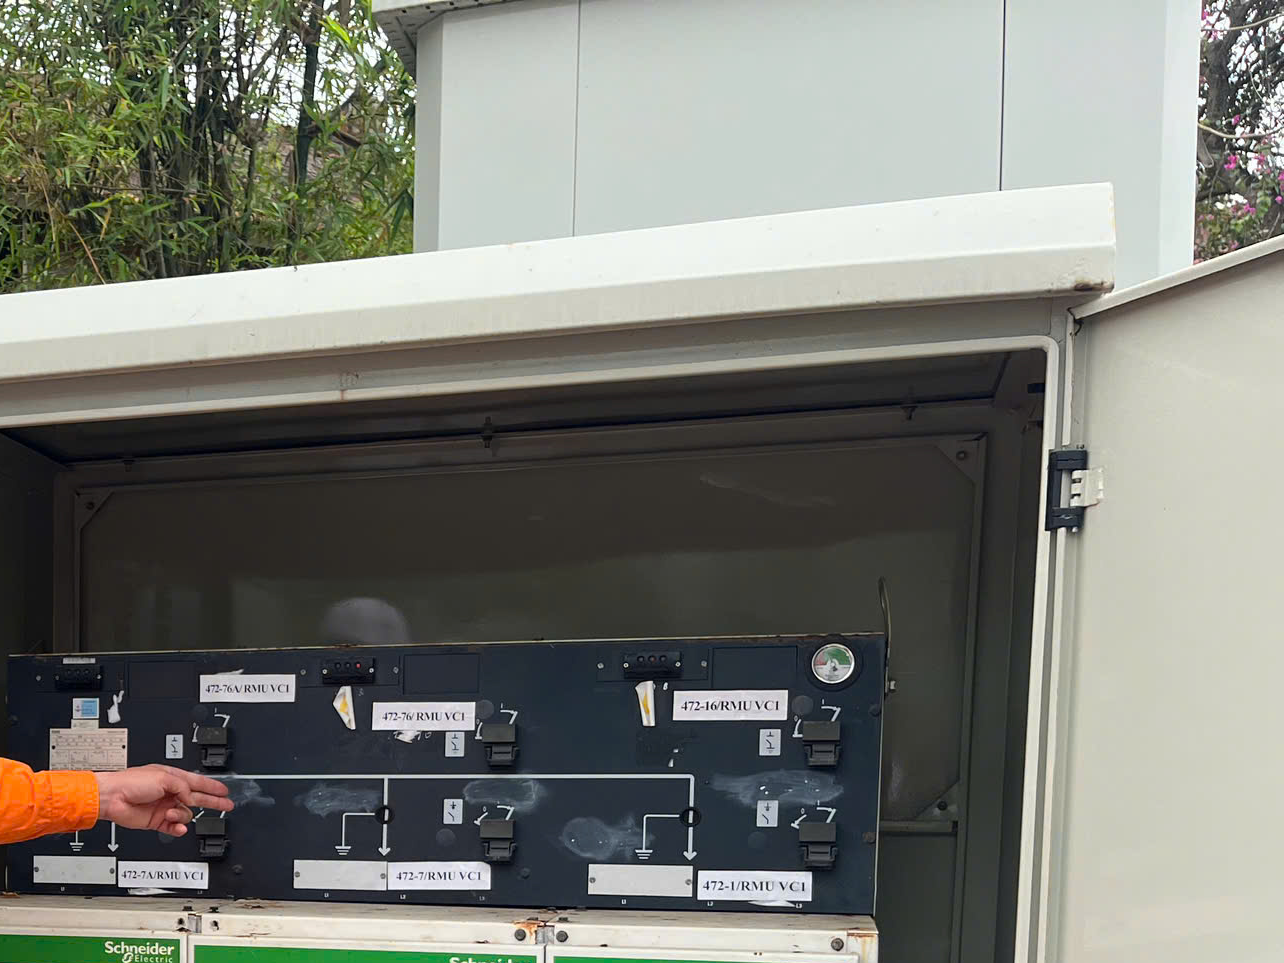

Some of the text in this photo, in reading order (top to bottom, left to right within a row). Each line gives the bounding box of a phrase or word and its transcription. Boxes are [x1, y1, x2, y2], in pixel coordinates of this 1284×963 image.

[270, 684, 290, 694] VC1
[755, 700, 779, 711] VC1
[445, 712, 466, 721] VC1
[183, 871, 204, 881] VC1
[459, 871, 482, 881] VC1
[703, 881, 805, 892] 472-1/RMU VC1
[104, 941, 175, 955] Schneider
[134, 954, 173, 963] Electric
